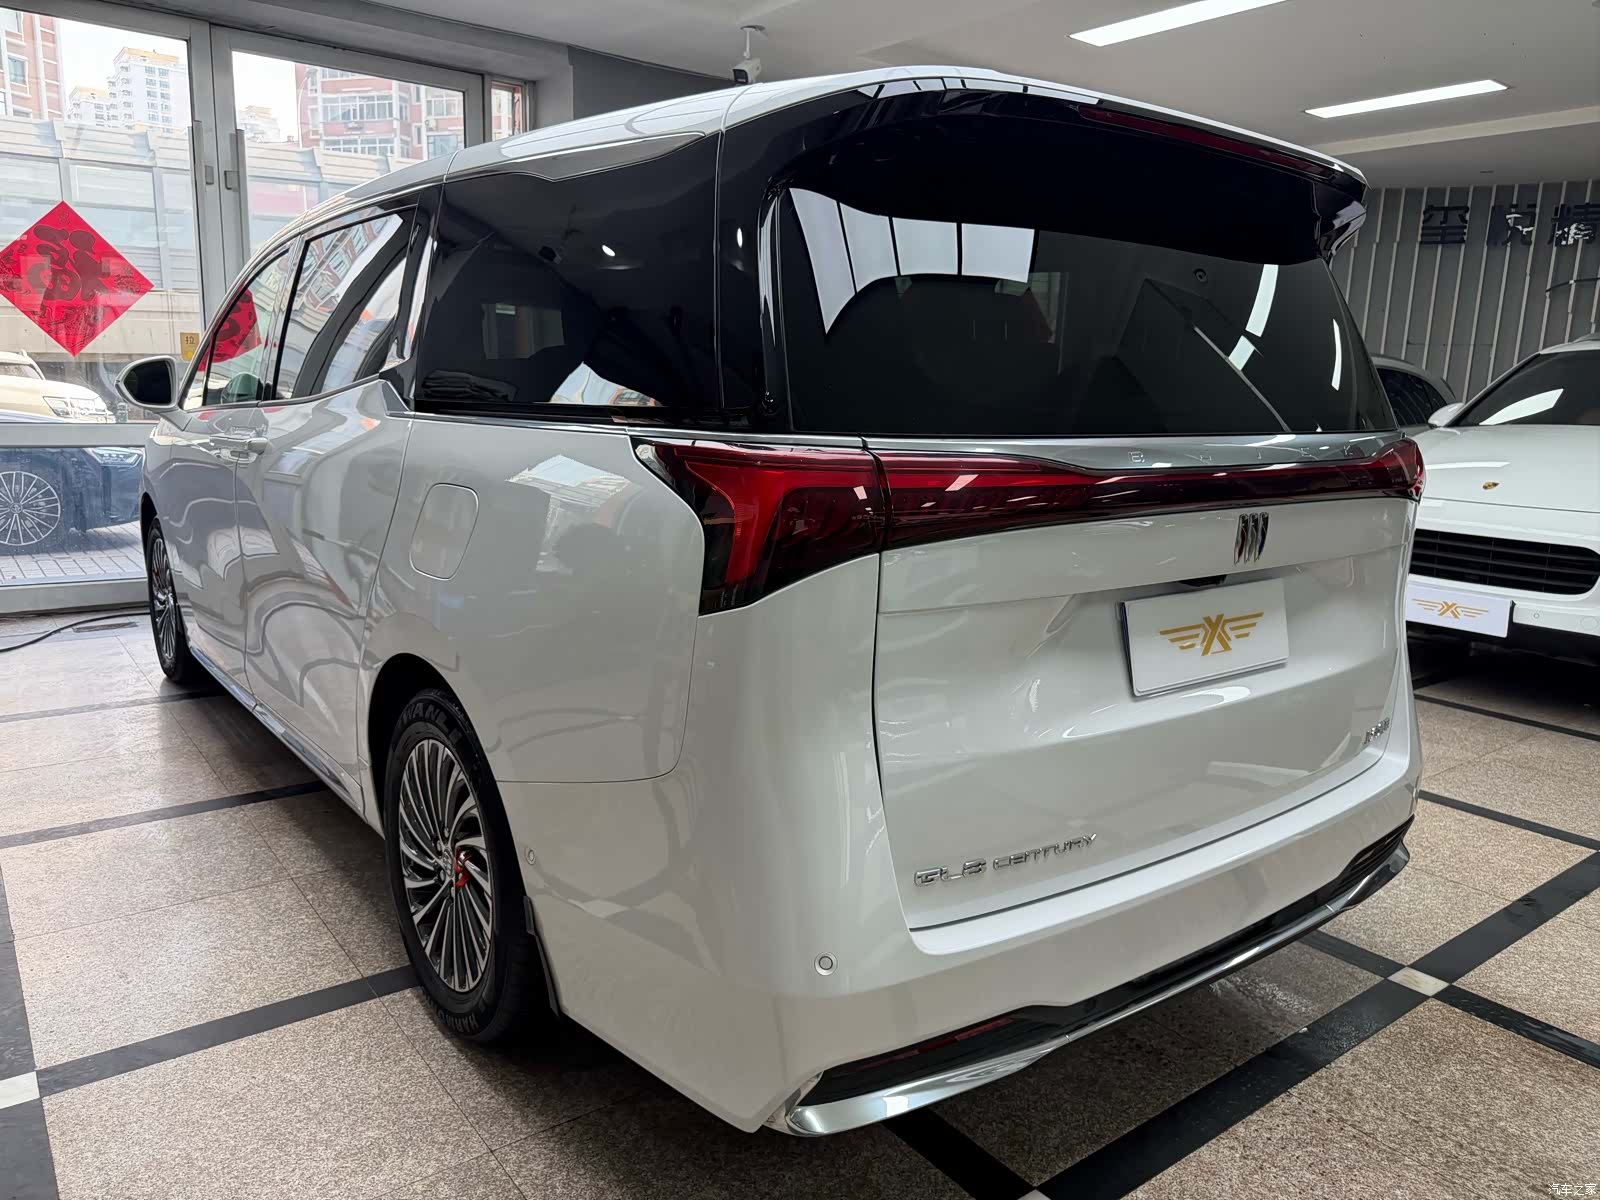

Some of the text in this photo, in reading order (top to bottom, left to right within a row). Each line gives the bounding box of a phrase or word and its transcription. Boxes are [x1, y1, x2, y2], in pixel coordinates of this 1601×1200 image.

[184, 335, 196, 345] 拉
[913, 833, 1097, 888] GL8 CENTURY
